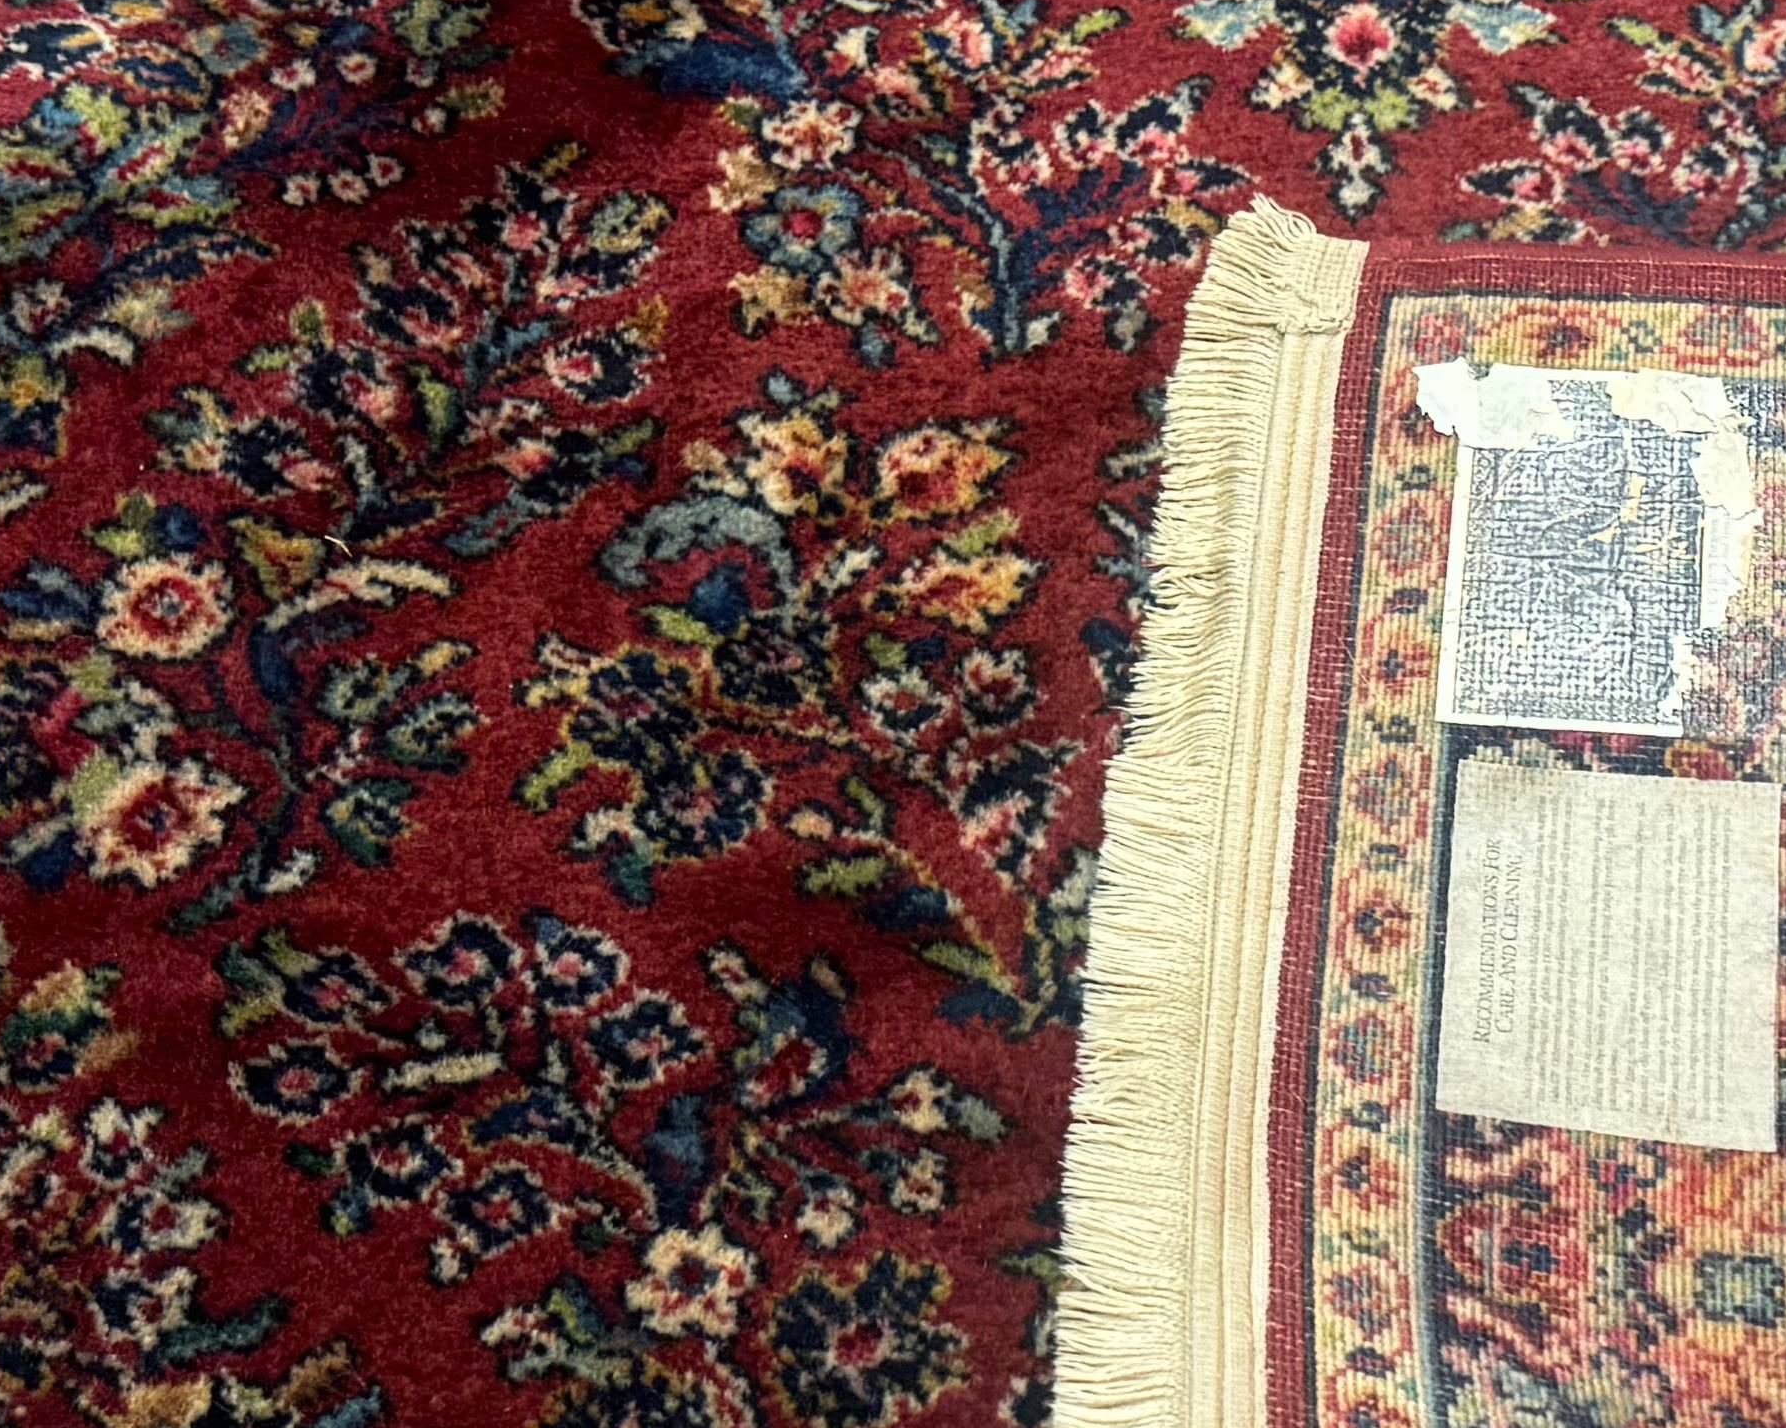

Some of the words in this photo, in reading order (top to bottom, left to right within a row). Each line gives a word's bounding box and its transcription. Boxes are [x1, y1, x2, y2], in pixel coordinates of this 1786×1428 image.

[1482, 838, 1501, 871] FOR
[1500, 853, 1522, 941] CLEANING
[1472, 874, 1499, 1043] RECOMMENDATIONS
[1498, 943, 1517, 984] AND
[1494, 985, 1515, 1034] CARE
